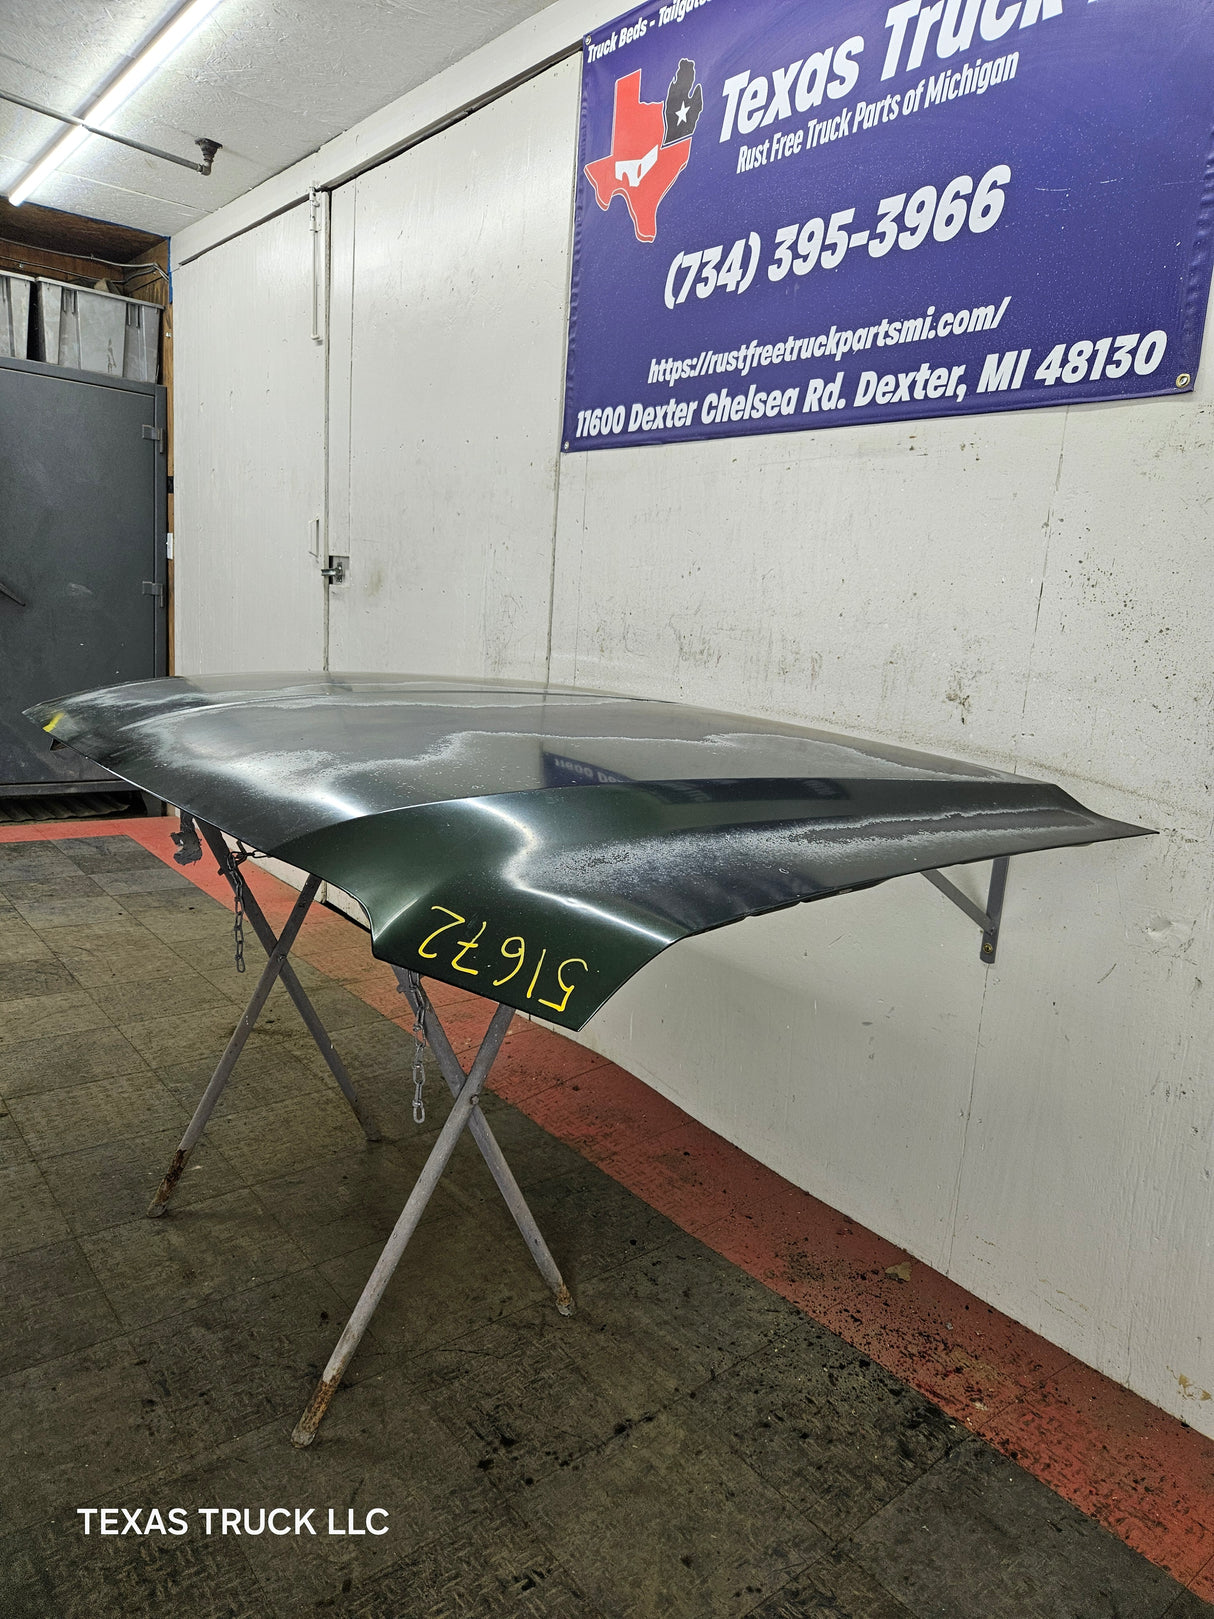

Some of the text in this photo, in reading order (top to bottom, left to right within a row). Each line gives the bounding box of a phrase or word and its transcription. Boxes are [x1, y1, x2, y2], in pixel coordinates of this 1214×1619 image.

[587, 30, 618, 63] Truck
[618, 17, 648, 48] Beds
[719, 0, 1064, 143] Texas Truc
[736, 51, 1020, 174] Rust Free Truck Parts of Michigan
[664, 165, 1012, 309] (734) 395-3966
[576, 330, 1168, 438] 11600 Dexter Chelsea Rd. Dexter, MI 48130
[648, 296, 1012, 387] https://rustfreetruckpartsmi.com/
[418, 905, 589, 1012] 51672
